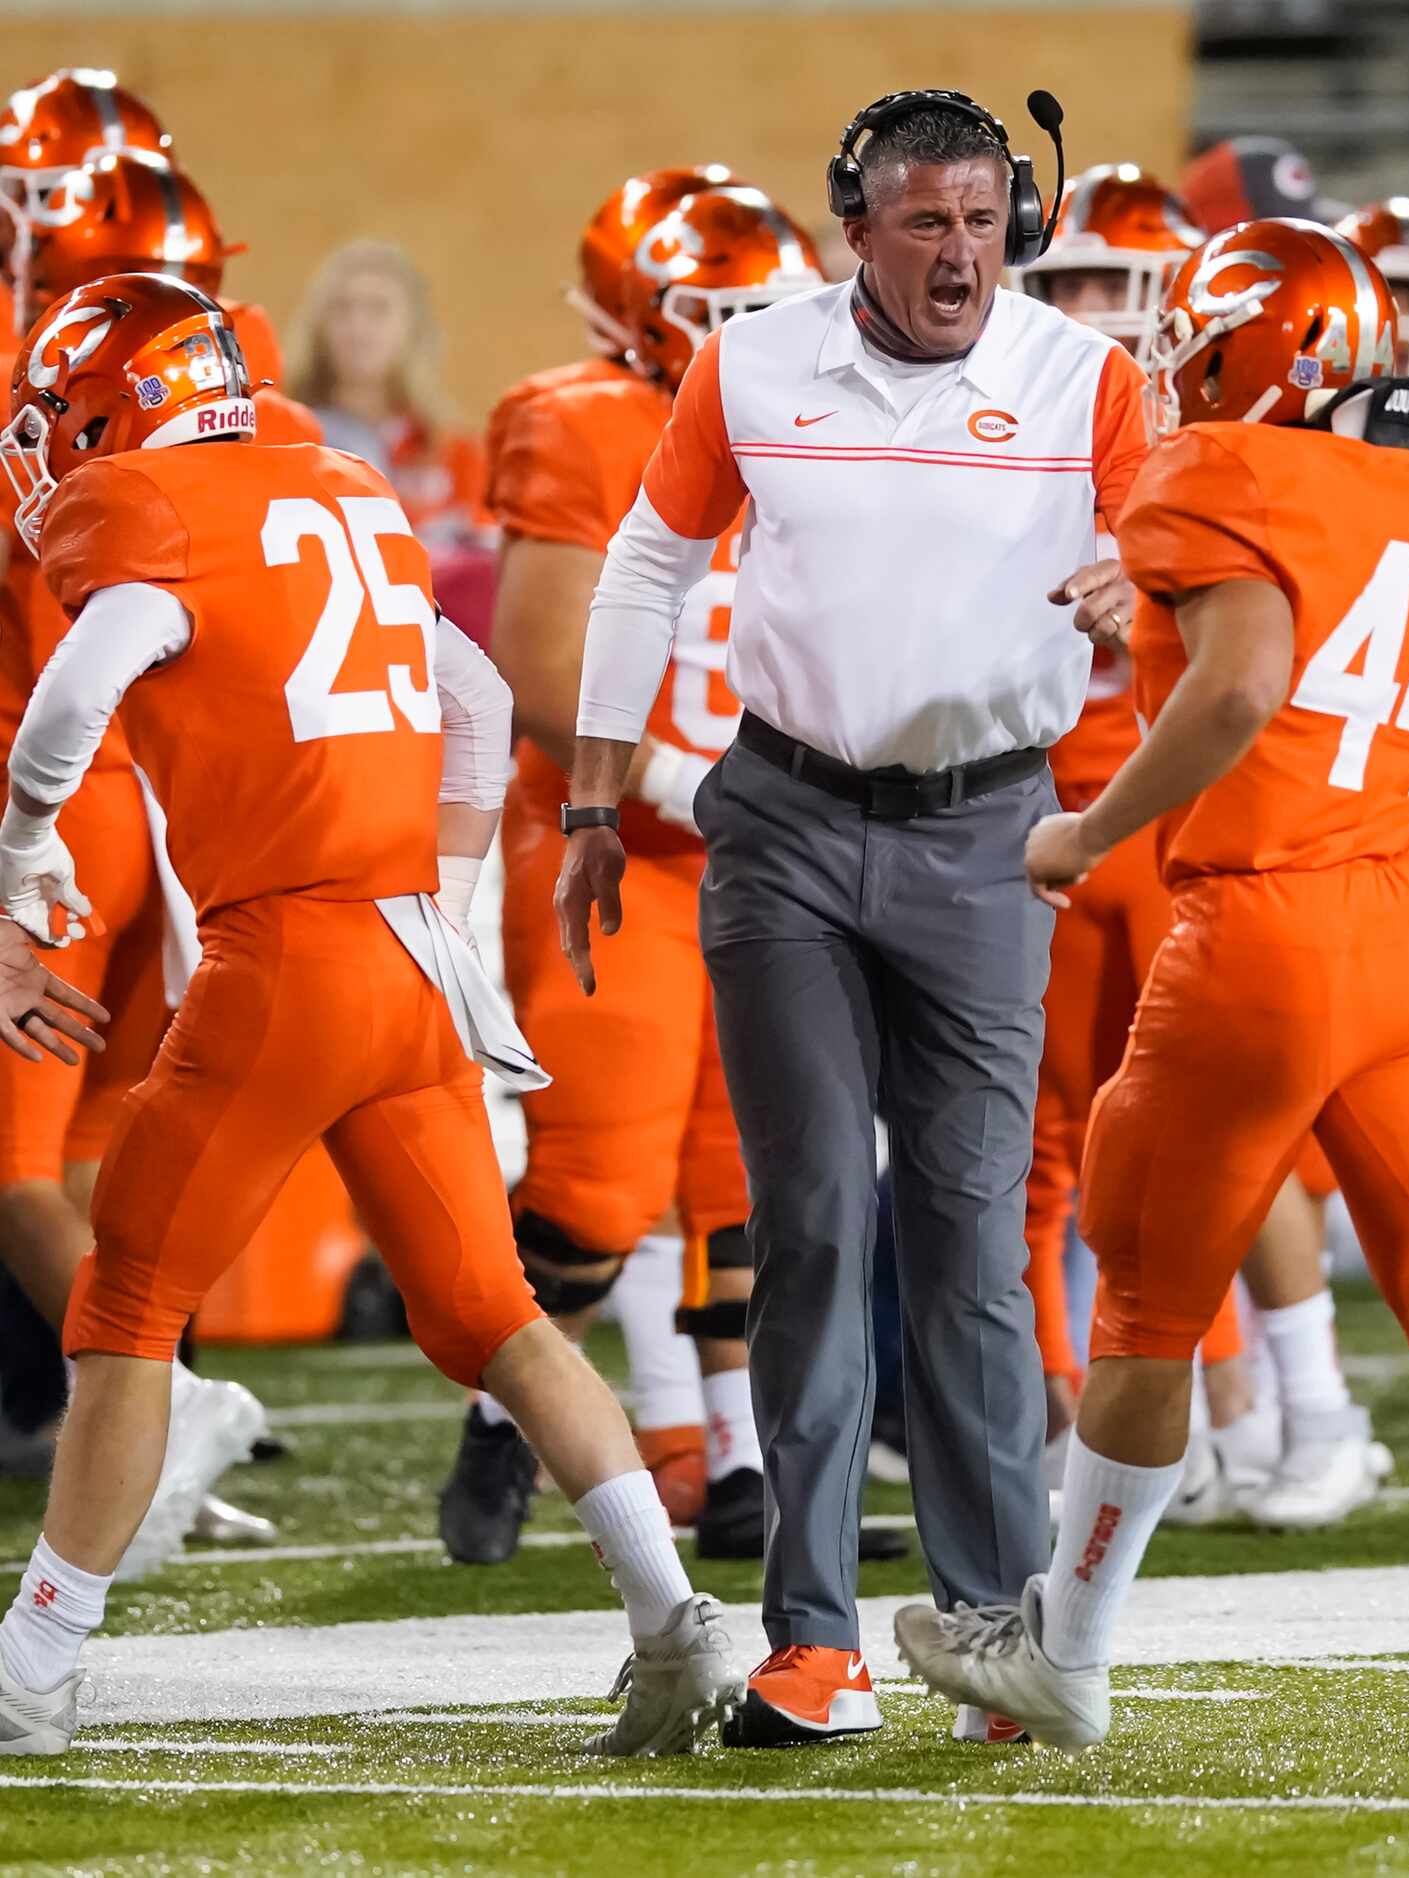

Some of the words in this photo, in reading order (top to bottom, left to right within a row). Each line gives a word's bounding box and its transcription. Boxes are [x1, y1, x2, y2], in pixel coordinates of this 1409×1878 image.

[1188, 250, 1285, 314] C
[28, 306, 113, 388] C
[967, 409, 1019, 442] C
[260, 496, 443, 744] 25
